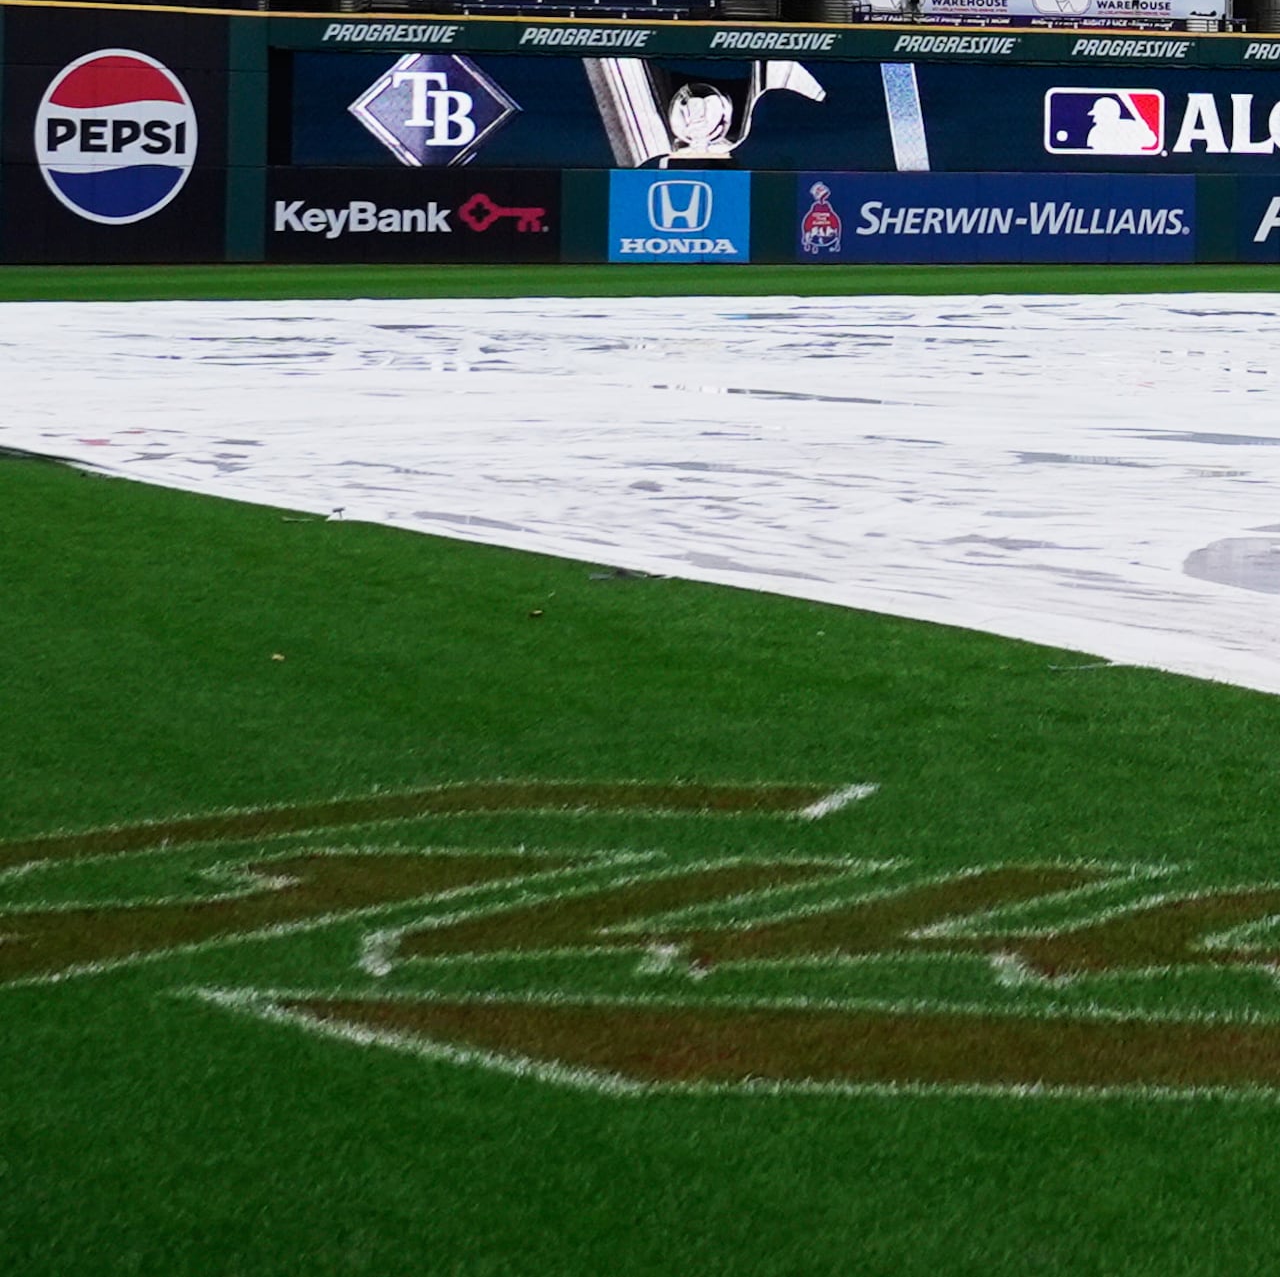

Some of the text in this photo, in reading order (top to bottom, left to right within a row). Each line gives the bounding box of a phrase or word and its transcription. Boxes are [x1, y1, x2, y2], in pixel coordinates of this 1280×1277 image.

[1096, 0, 1172, 11] WAREHOUSE
[321, 24, 461, 44] PROGRESSIVE
[518, 27, 653, 48] PROGRESSIVE
[709, 31, 837, 51] PROGRESSIVE
[893, 34, 1018, 55] PROGRESSIVE
[1071, 38, 1192, 59] PROGRESSIVE
[392, 70, 476, 148] TB
[46, 118, 187, 155] PEPSI
[274, 199, 453, 240] KeyBank
[856, 200, 1184, 236] SHERWIN-WILLIAMS
[620, 238, 738, 255] HONDA
